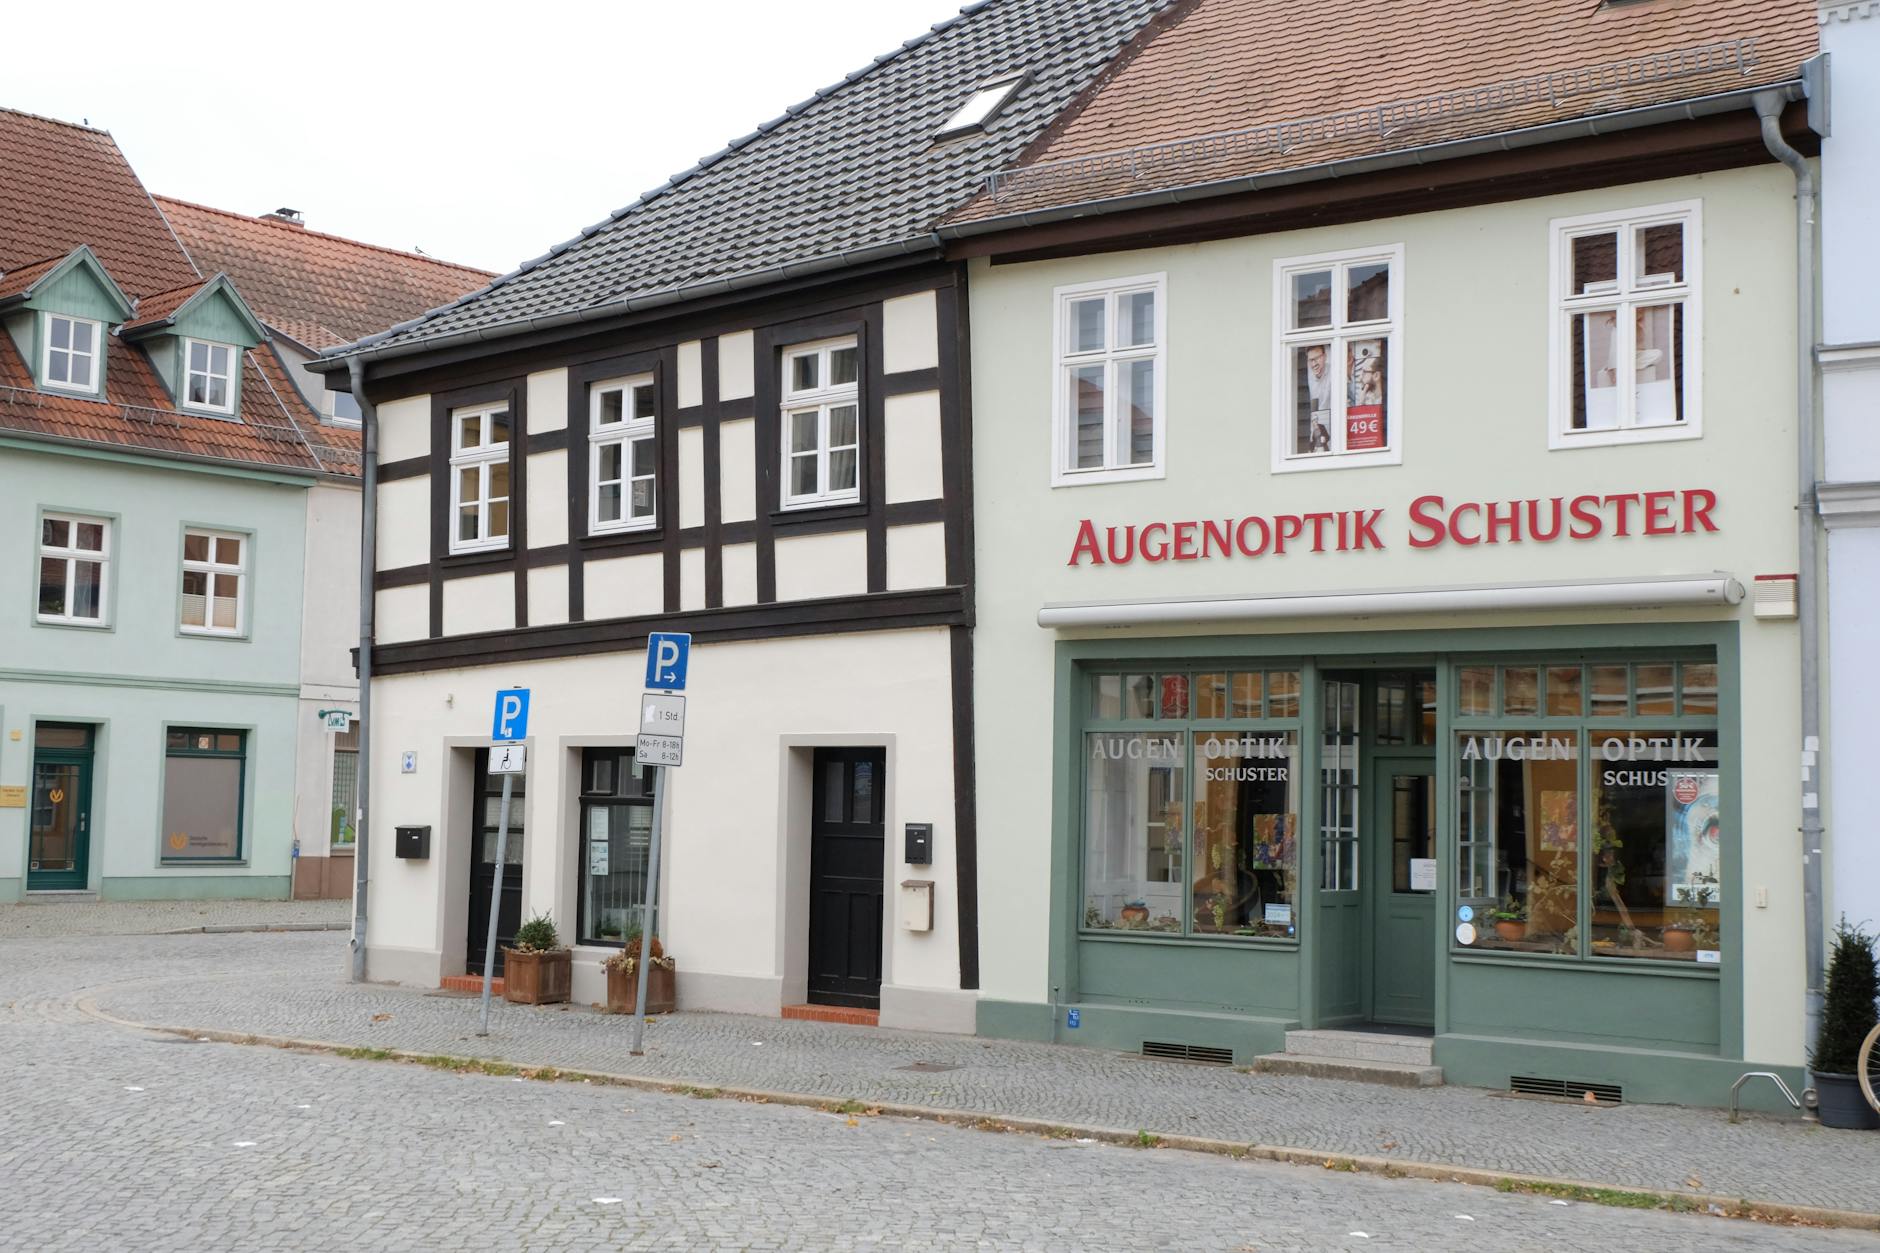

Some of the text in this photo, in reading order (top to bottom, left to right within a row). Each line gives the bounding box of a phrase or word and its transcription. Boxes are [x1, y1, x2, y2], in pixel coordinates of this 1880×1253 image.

[1067, 488, 1721, 566] AUGENOPTIK SCHUSTER
[654, 639, 680, 683] P
[500, 695, 521, 736] P
[1092, 737, 1288, 760] AUGEN OPTIK
[1461, 736, 1706, 762] AUGEN OPTIK
[1206, 767, 1288, 782] SCHUSTER
